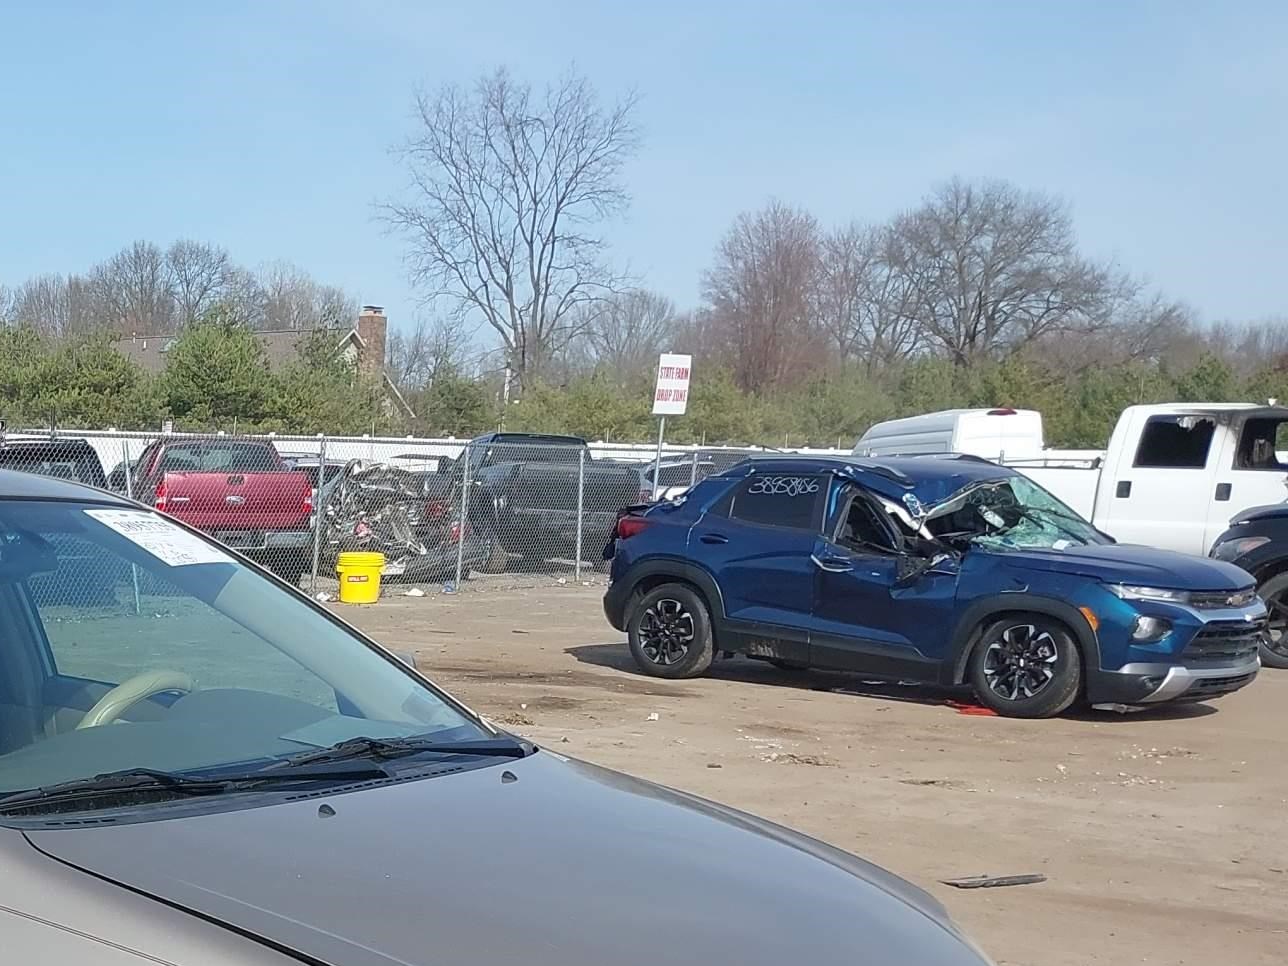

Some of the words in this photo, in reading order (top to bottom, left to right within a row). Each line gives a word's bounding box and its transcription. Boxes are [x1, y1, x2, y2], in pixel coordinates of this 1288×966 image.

[660, 366, 675, 380] STATE
[675, 367, 689, 380] FARM
[656, 388, 672, 401] DROP
[672, 389, 687, 402] ZONE
